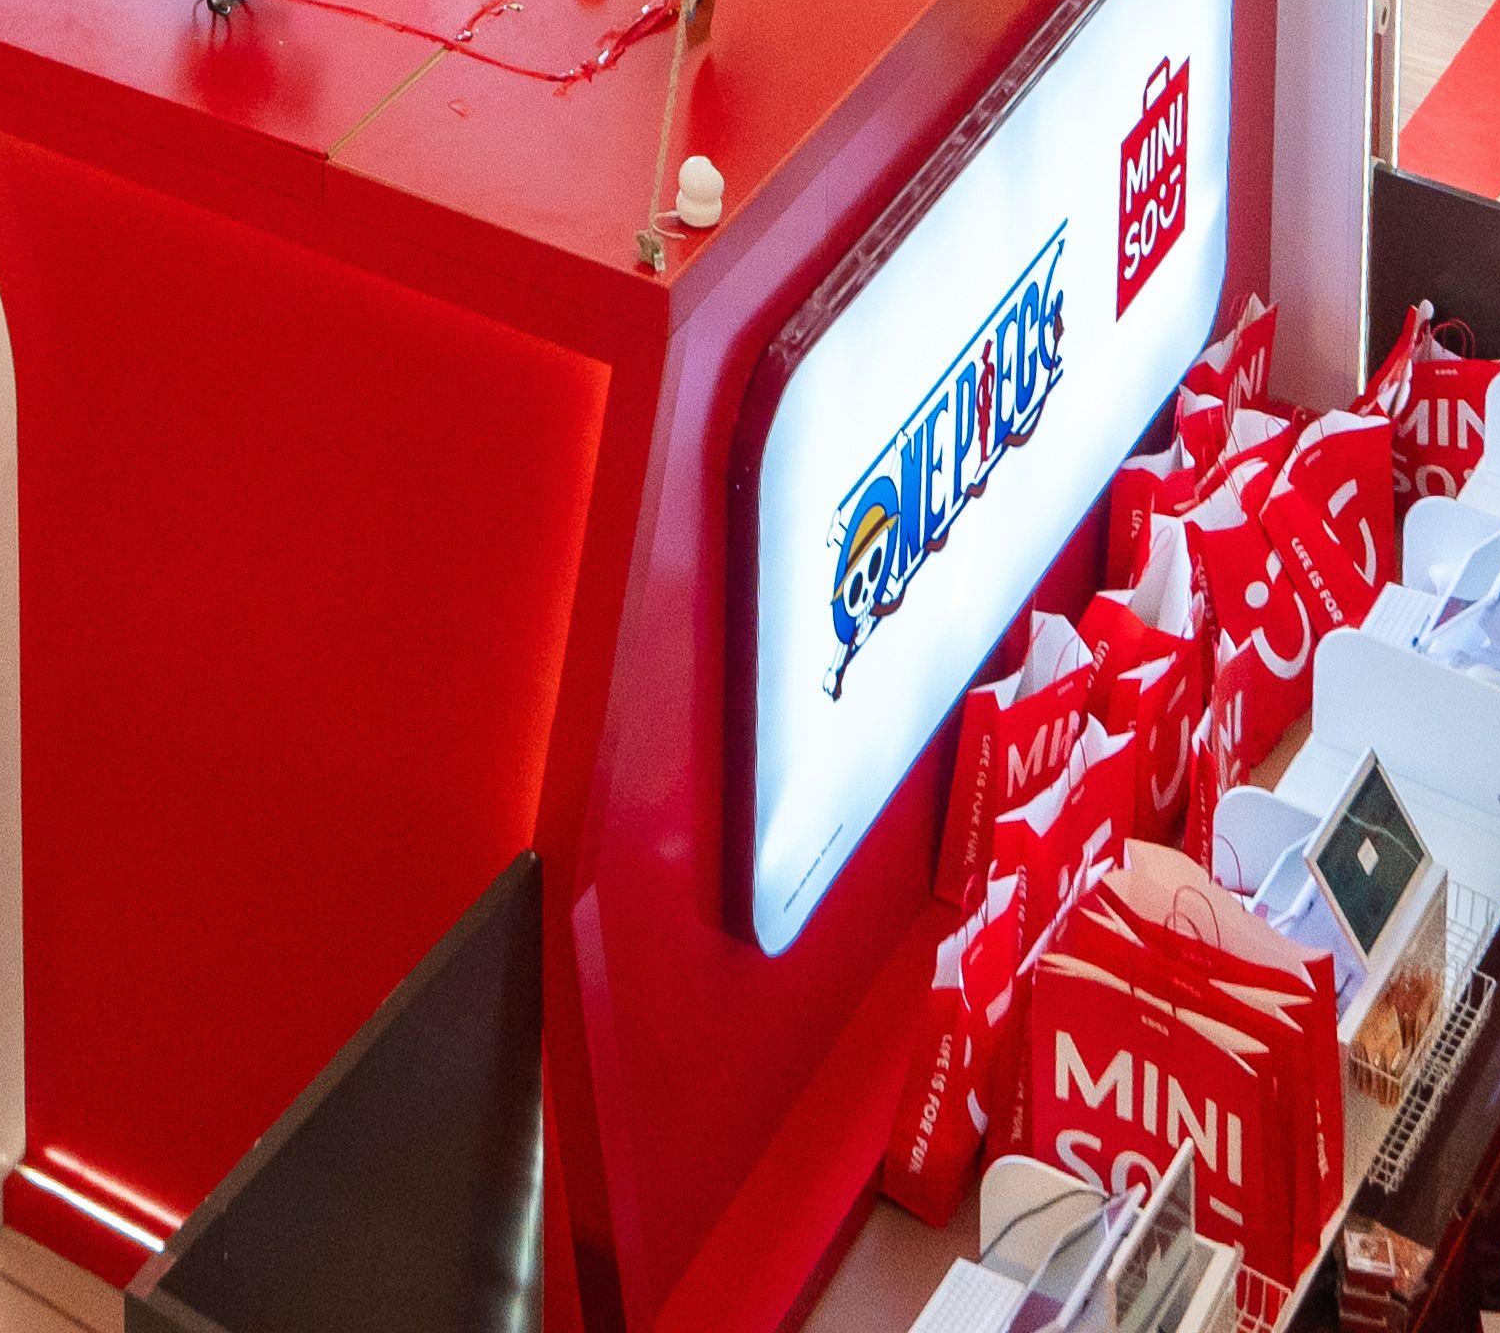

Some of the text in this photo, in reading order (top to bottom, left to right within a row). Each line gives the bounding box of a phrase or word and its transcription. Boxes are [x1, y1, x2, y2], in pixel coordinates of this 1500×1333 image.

[1124, 94, 1184, 195] MINI
[1393, 398, 1486, 452] MIN
[1290, 537, 1310, 572] LIFE
[938, 1032, 953, 1069] LIFE
[1055, 1030, 1244, 1187] MINI
